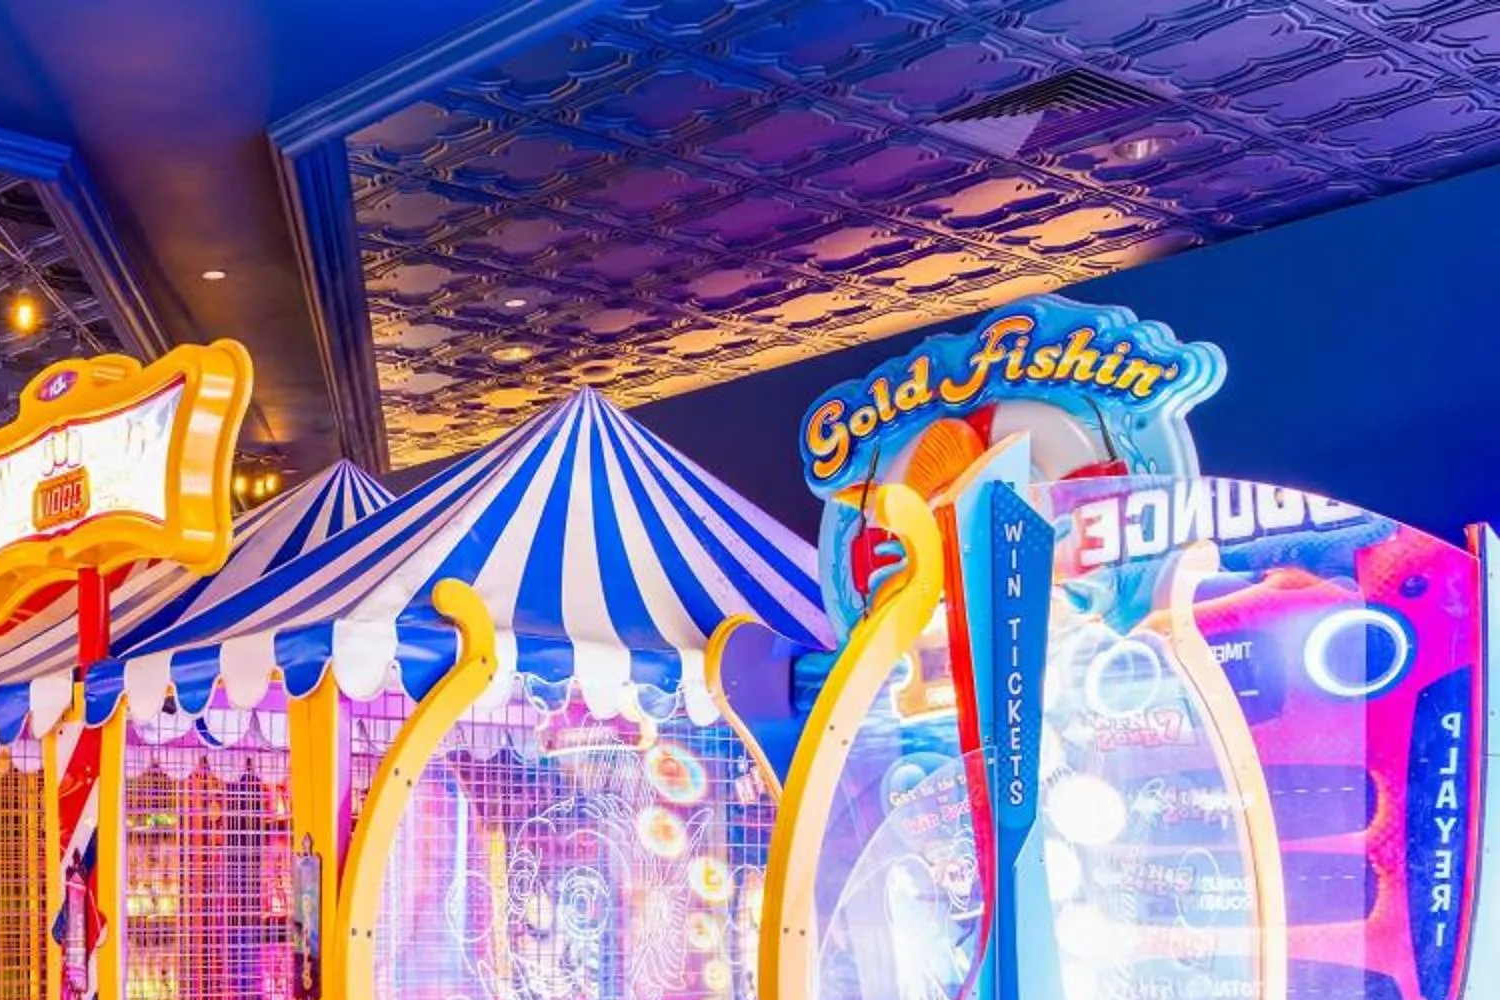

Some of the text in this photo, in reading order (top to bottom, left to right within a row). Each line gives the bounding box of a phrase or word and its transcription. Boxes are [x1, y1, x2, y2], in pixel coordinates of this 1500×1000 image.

[805, 314, 1179, 480] Gold Fishin'
[1003, 519, 1025, 805] WIN TICKETS
